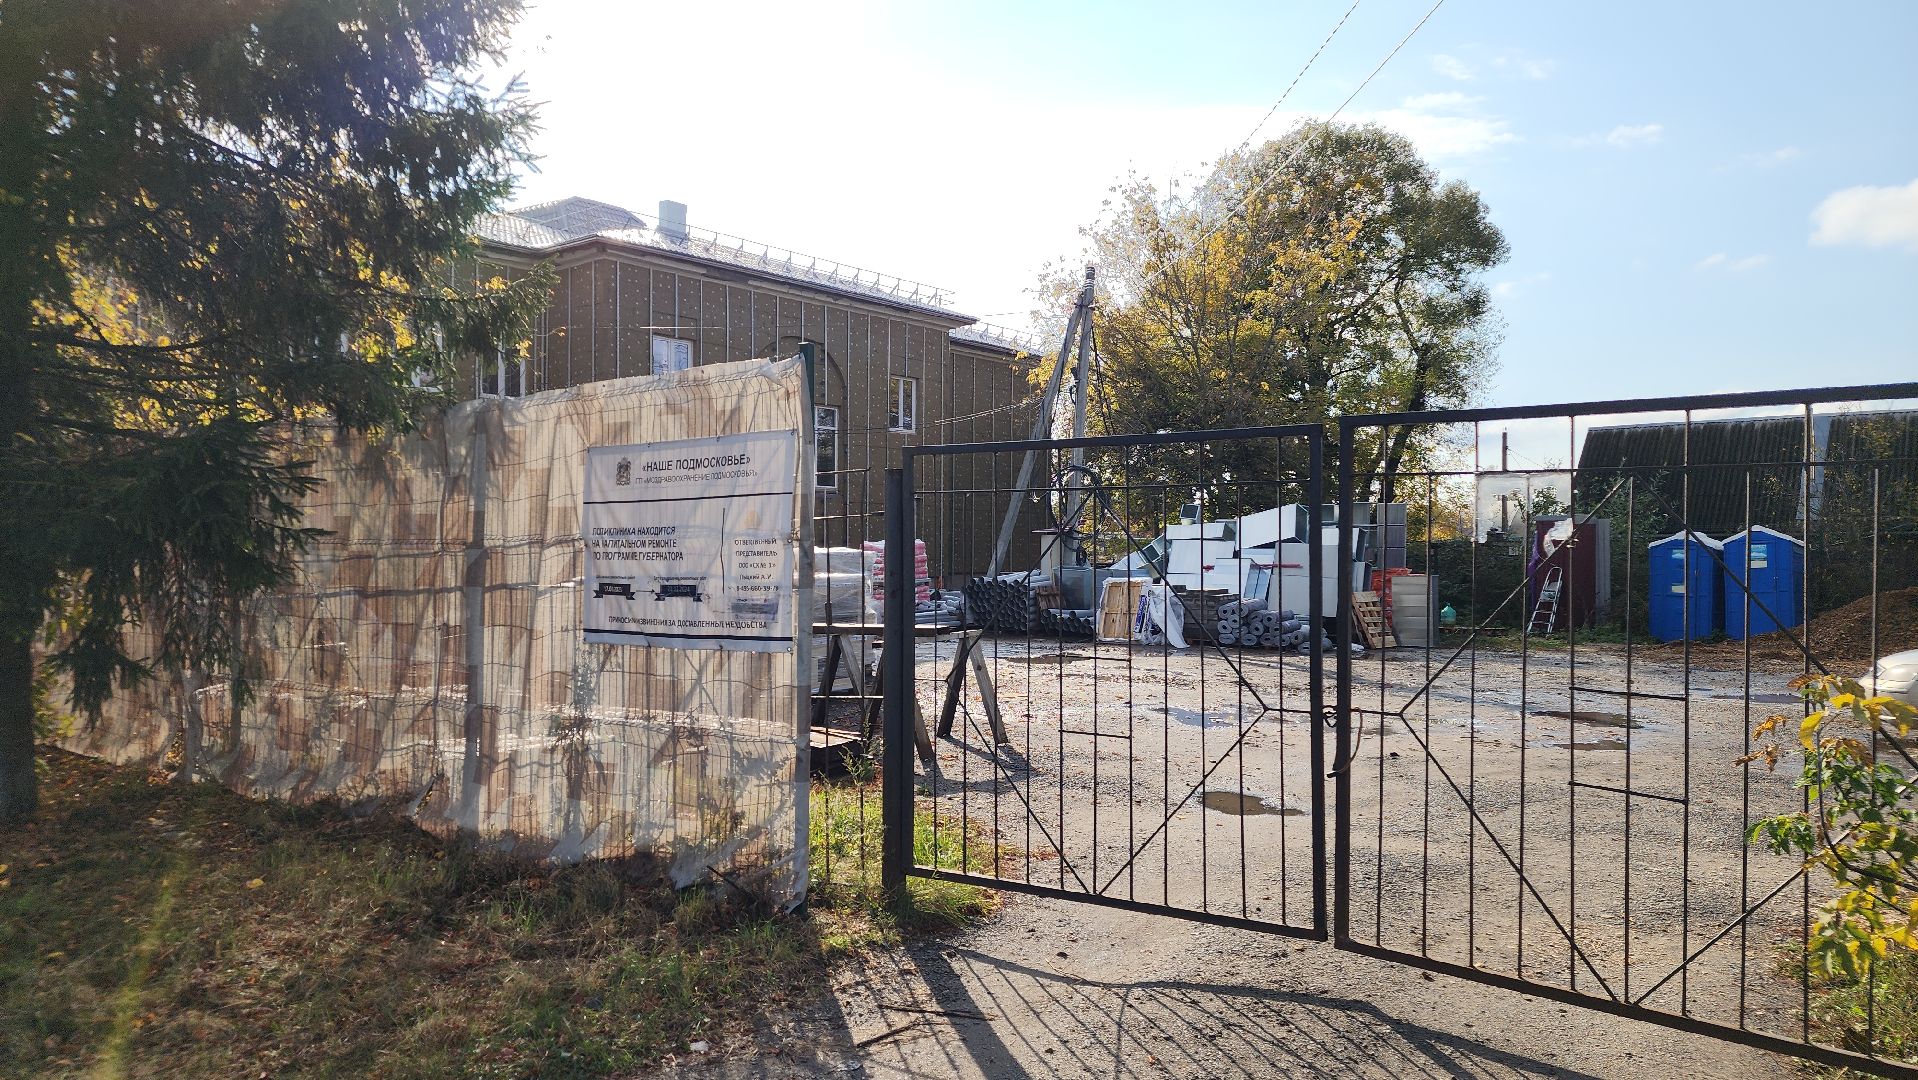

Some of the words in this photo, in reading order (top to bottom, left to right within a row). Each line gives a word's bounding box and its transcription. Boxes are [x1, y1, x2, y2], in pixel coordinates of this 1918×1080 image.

[642, 460, 673, 472] «НАШЕ
[675, 454, 751, 471] ПОДМОСКОВЬЕ»
[637, 526, 676, 536] НАХОДИТСЯ
[648, 539, 677, 548] РЕМОНТЕ
[638, 551, 684, 561] ГУБЕРНАТОРА
